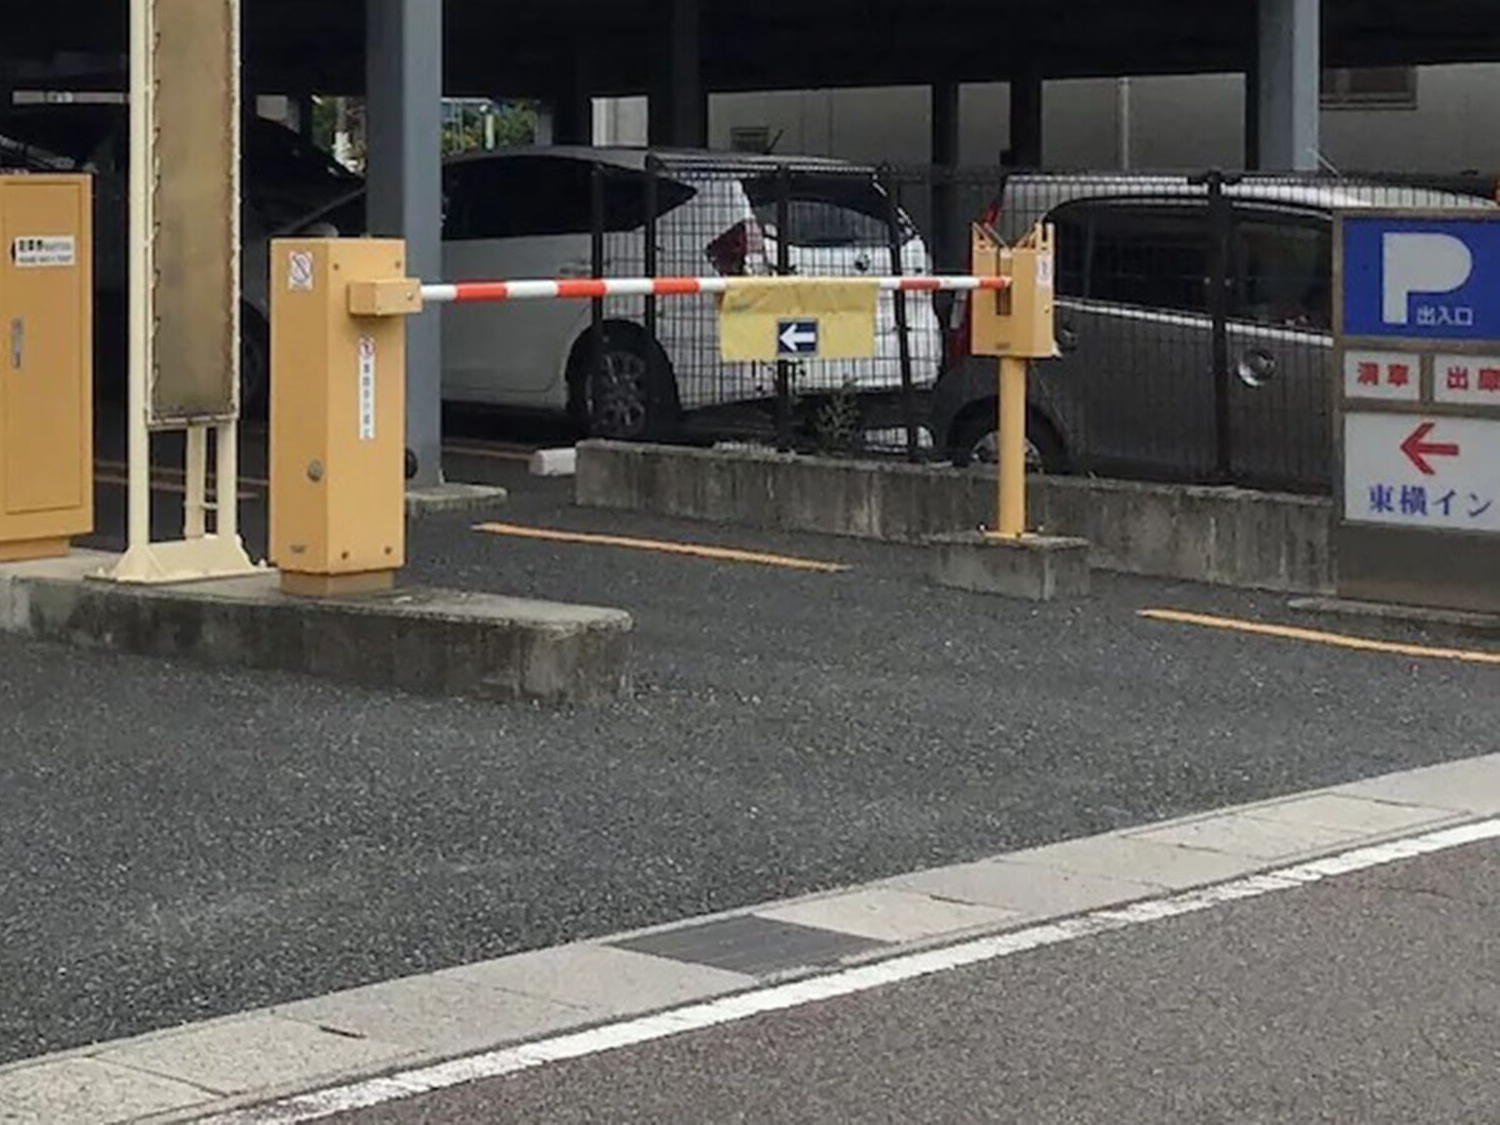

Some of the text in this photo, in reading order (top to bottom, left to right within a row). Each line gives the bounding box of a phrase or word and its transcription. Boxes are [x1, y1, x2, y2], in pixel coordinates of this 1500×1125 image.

[1383, 232, 1473, 323] P
[1416, 307, 1474, 325] 出入口
[1369, 483, 1492, 517] 東横イン
